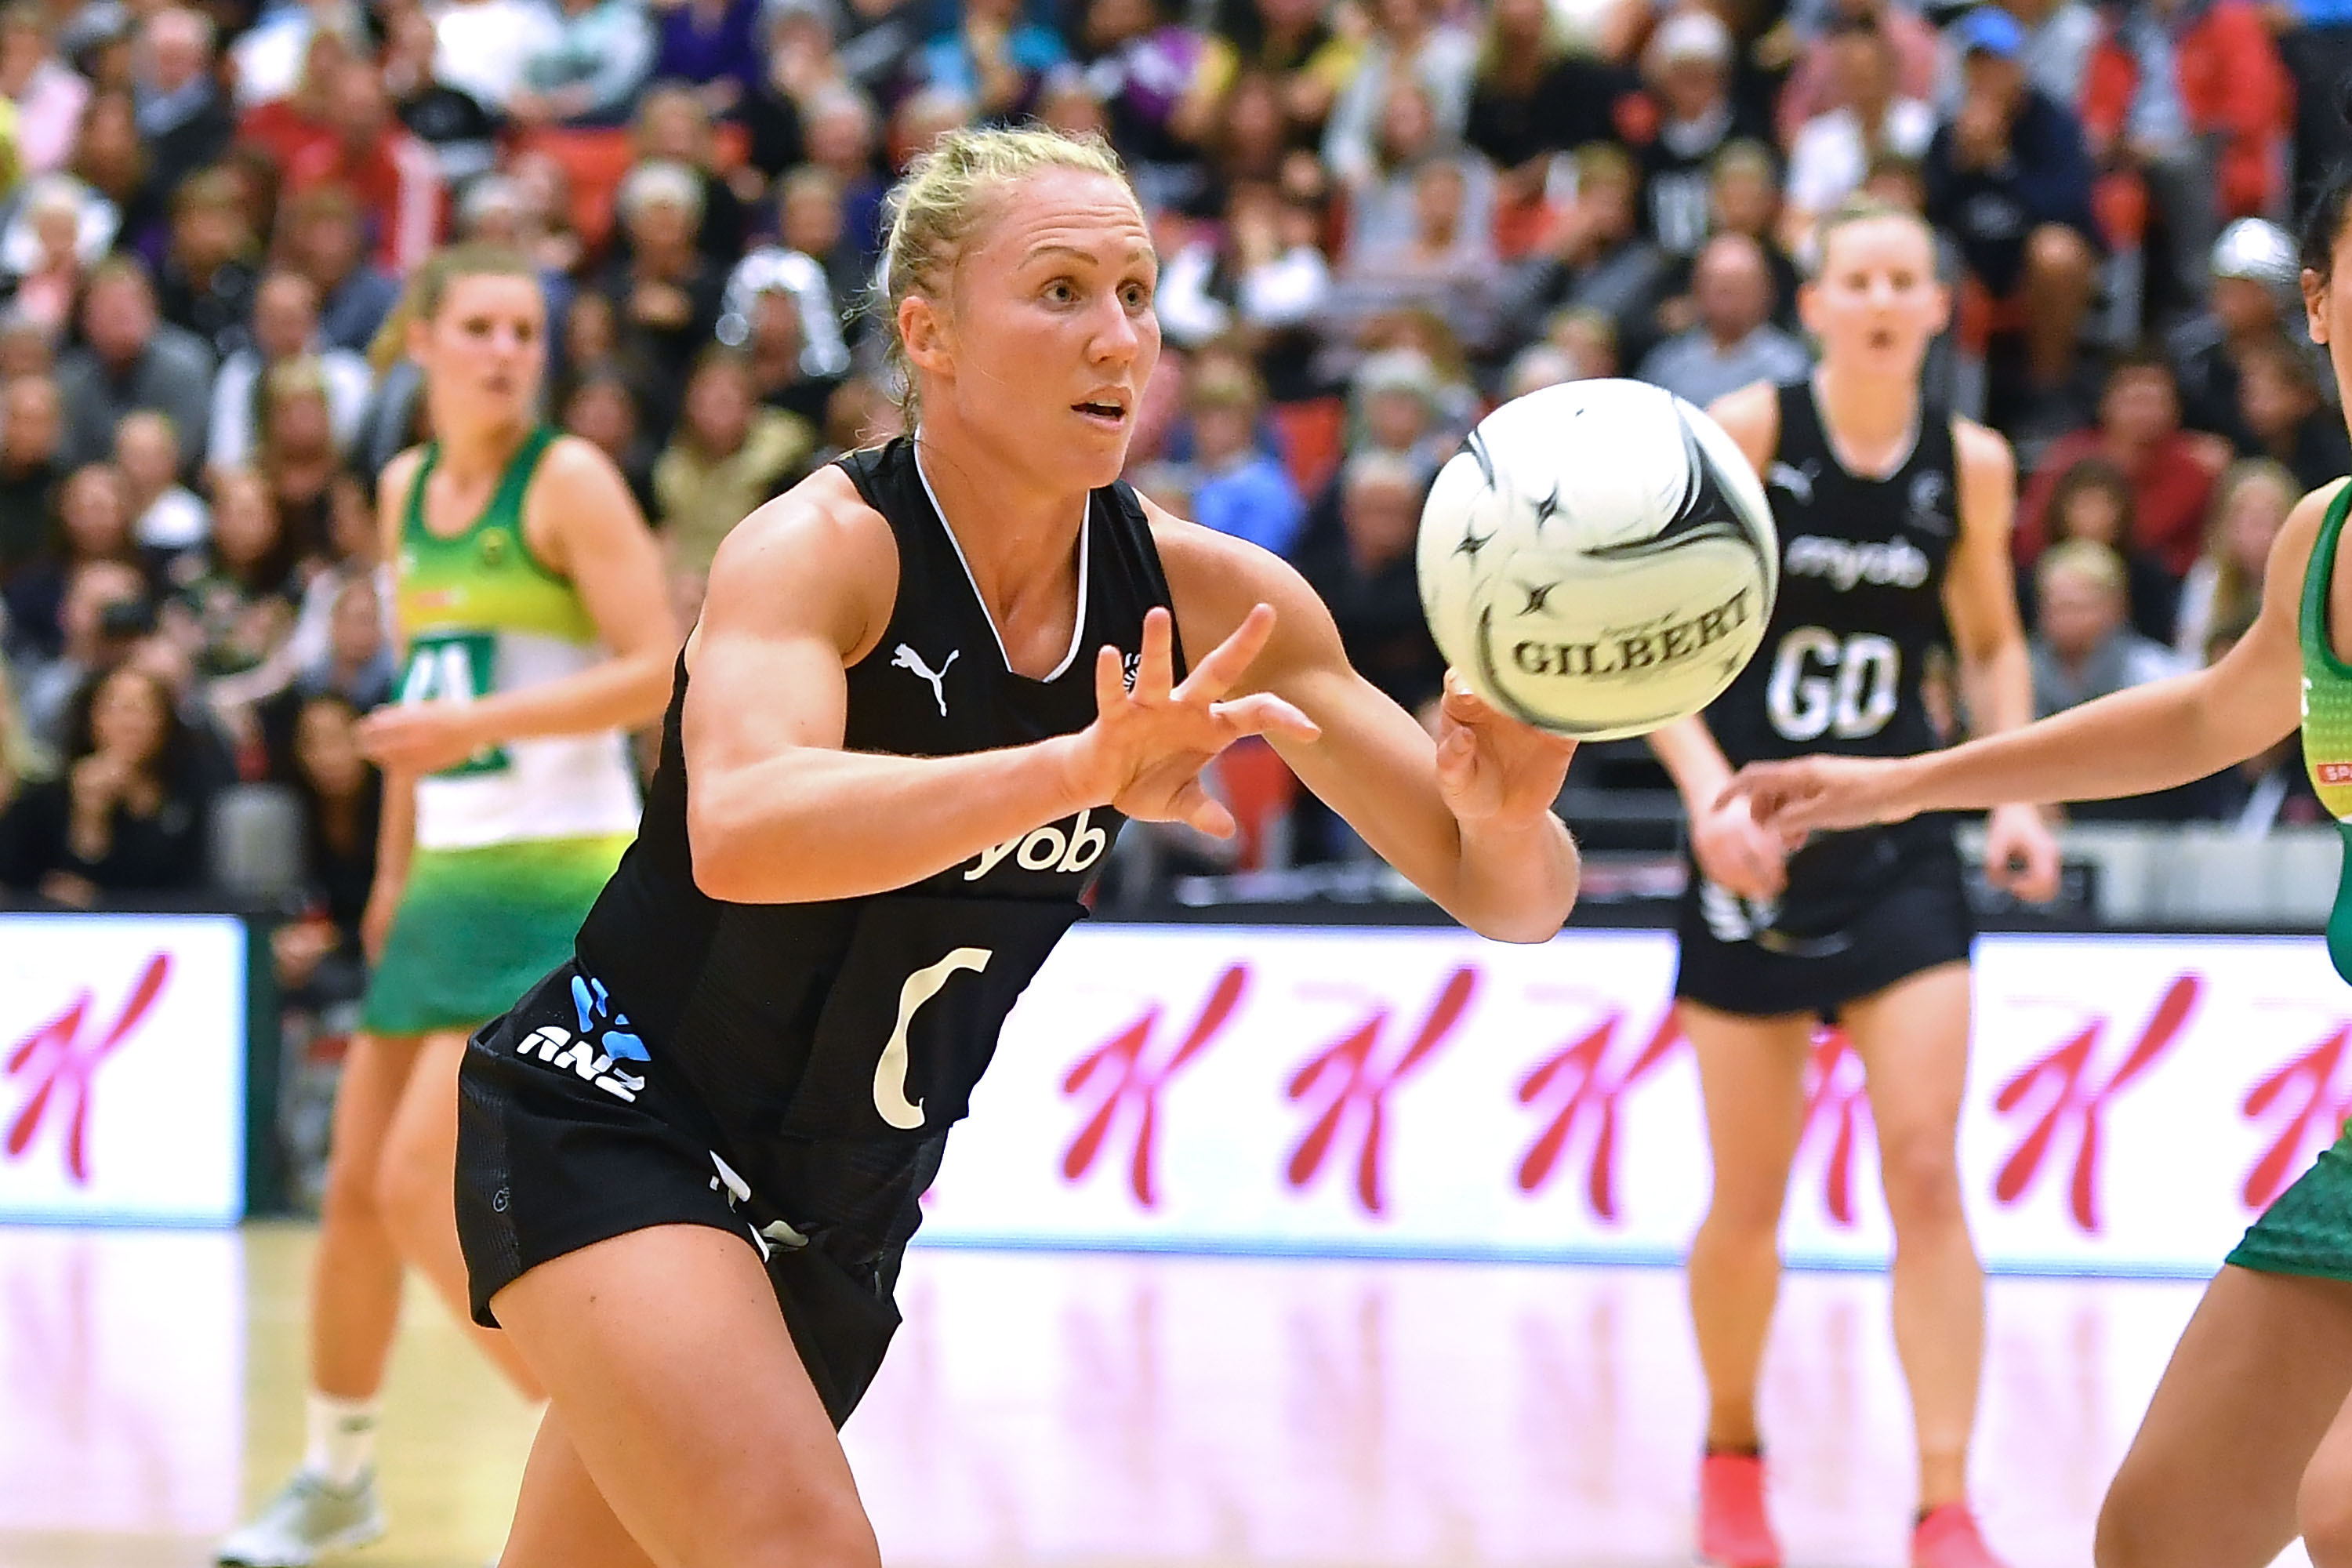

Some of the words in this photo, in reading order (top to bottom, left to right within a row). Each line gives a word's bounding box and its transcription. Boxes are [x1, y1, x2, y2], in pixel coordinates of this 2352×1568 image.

[1512, 586, 1750, 676] GILBERT
[1766, 626, 1901, 742] GD
[2326, 765, 2352, 781] SP
[517, 1025, 644, 1102] ANZ
[873, 947, 993, 1130] C
